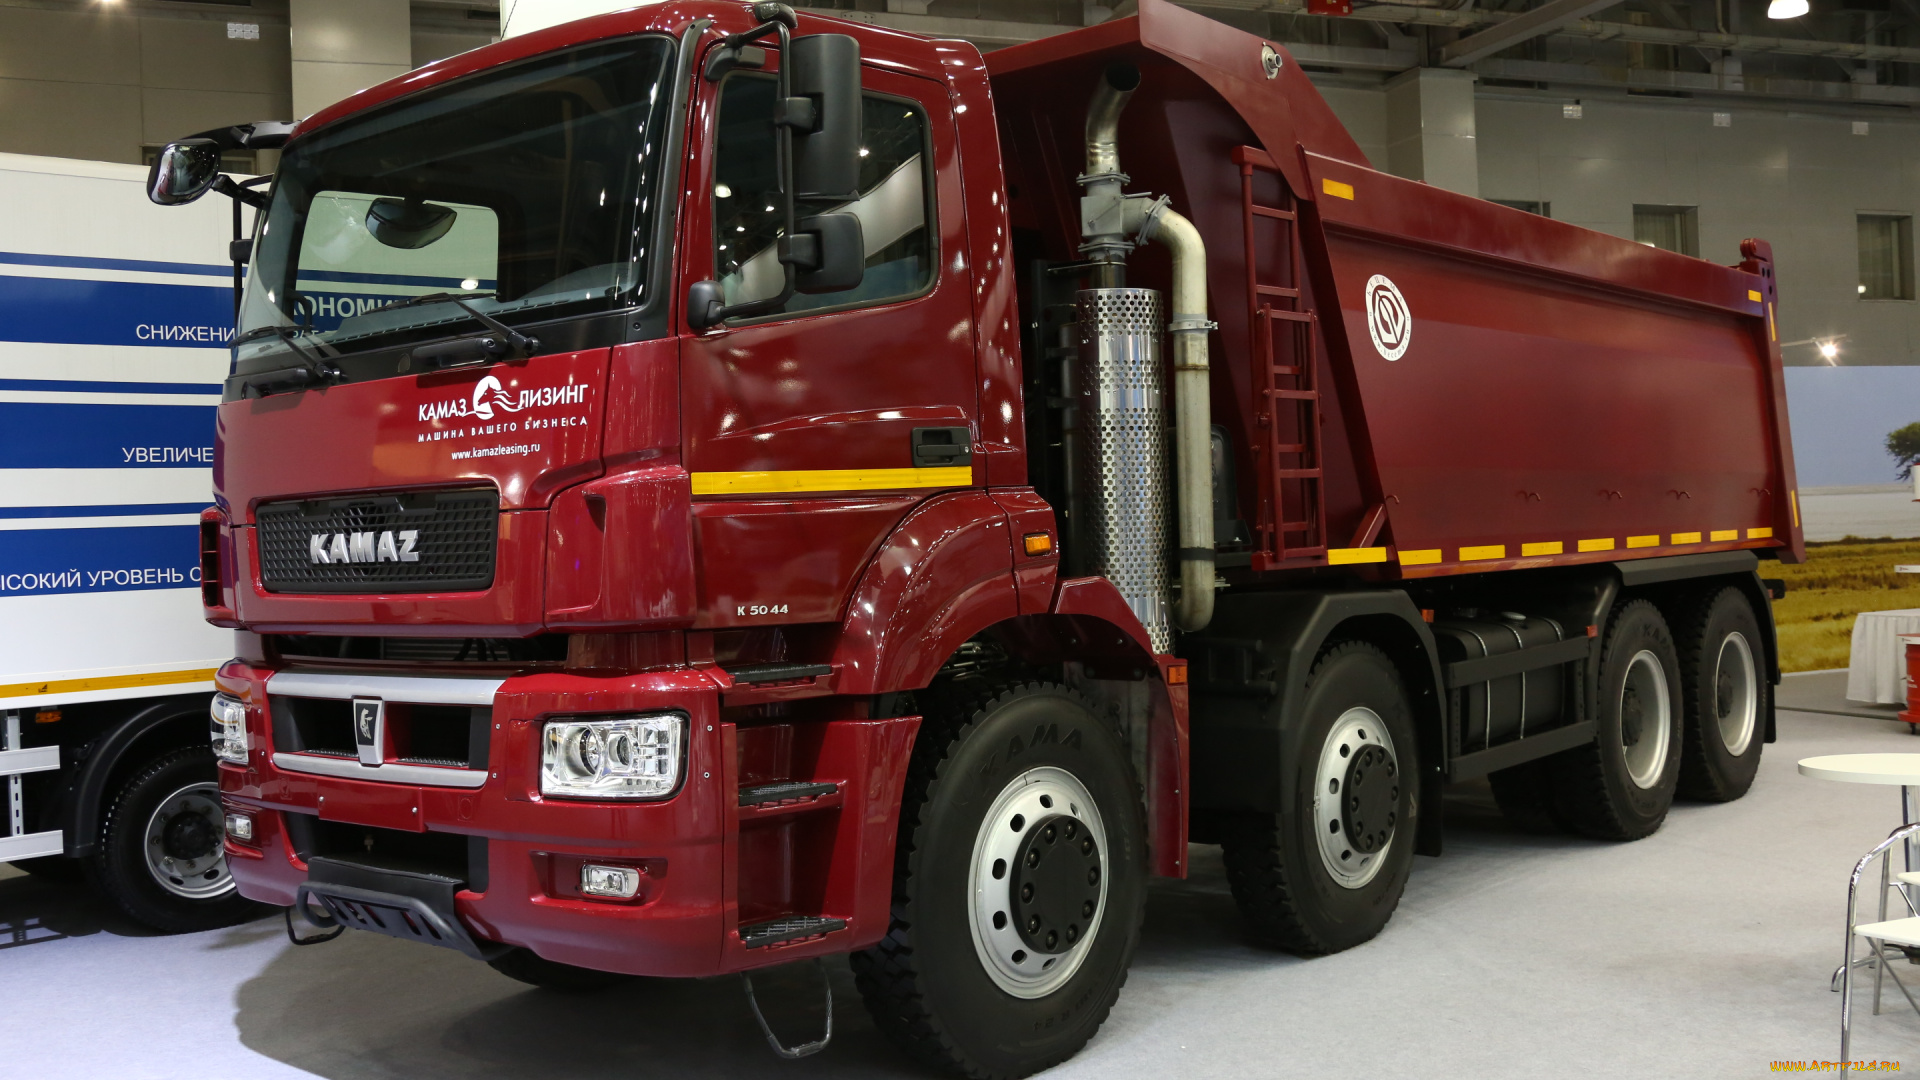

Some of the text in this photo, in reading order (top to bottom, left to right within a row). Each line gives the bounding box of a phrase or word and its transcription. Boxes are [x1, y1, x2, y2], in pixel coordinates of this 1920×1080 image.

[136, 324, 236, 342] СНИЖЕНИ
[418, 384, 589, 422] КАМАЗ ЛИЗИНГ
[418, 416, 588, 443] МАШИНА ВАШЕГО БИЗНЕСА
[121, 447, 213, 463] УВЕЛИЧЕ
[451, 442, 541, 461] www.kamazleasing.ru
[309, 529, 420, 564] KAMAZ
[1, 568, 81, 591] СОКИЙ
[86, 567, 184, 587] УРОВЕНЬ
